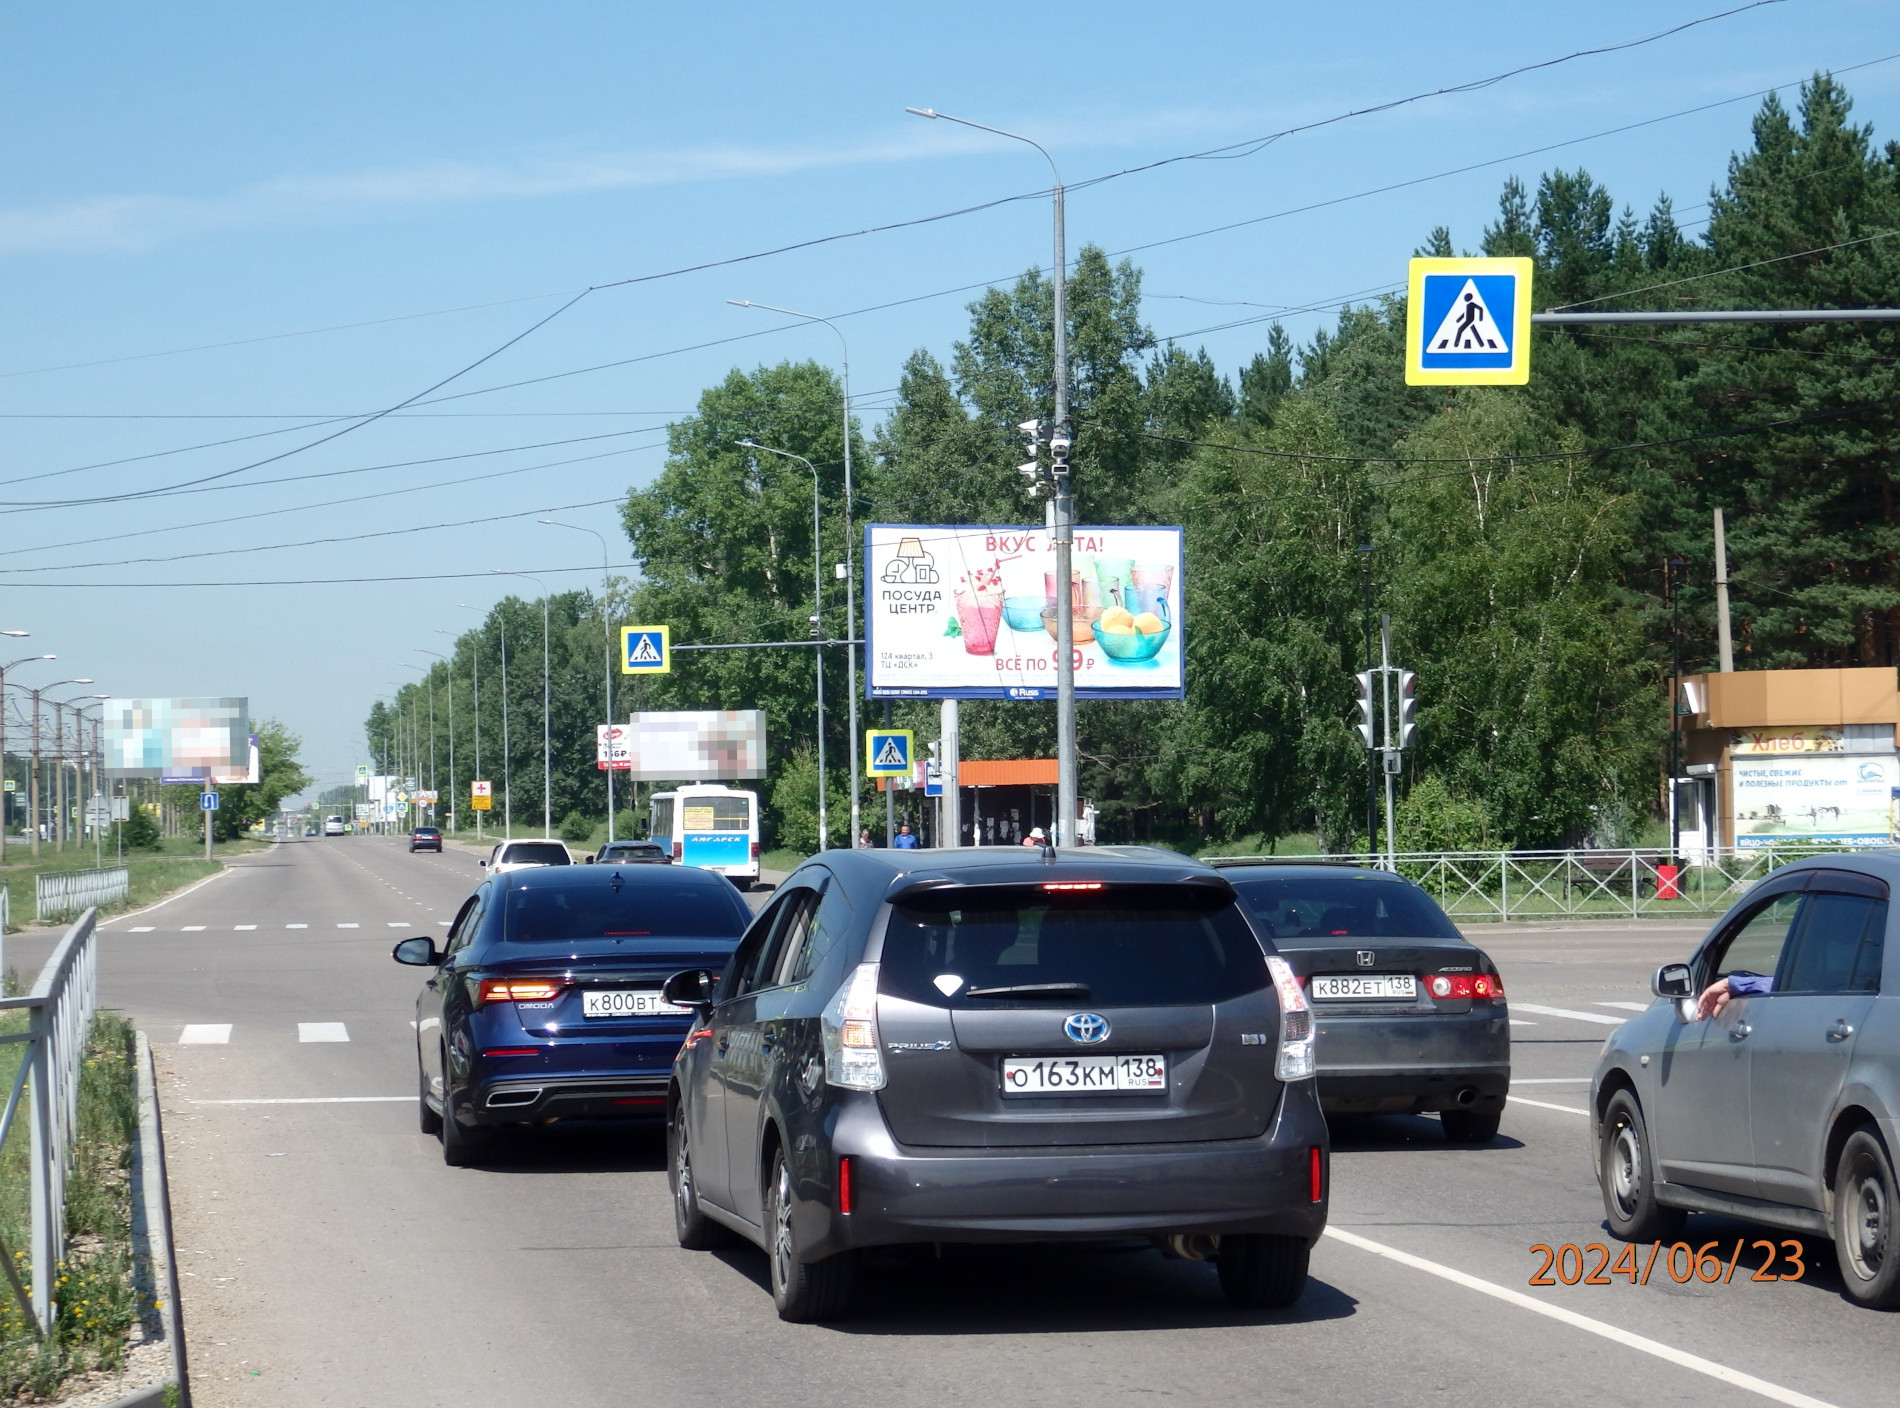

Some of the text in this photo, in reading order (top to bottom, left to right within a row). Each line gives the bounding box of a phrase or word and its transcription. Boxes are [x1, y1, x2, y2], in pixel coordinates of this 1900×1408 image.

[985, 536, 1104, 552] ВКУС ТА!
[882, 590, 942, 602] ПОСУДА
[889, 603, 936, 615] ЦЕНТР
[881, 661, 918, 669] ТЦ «ДСК»
[995, 654, 1022, 671] ВСЁ
[1026, 658, 1048, 671] ПО
[1018, 688, 1040, 697] Russ
[1752, 732, 1806, 751] Хлеб
[1738, 769, 1802, 778] ЧИСТЫЕ, СВЕЖИЕ
[1745, 780, 1783, 788] ПОЛЕЗНЫЕ
[1786, 779, 1832, 788] ПРОДУКТЫ
[1318, 976, 1411, 995] К882ЕТ 138
[589, 993, 657, 1012] К800ВТ
[1012, 1057, 1157, 1087] О163КМ 138
[1128, 1078, 1147, 1086] RUS
